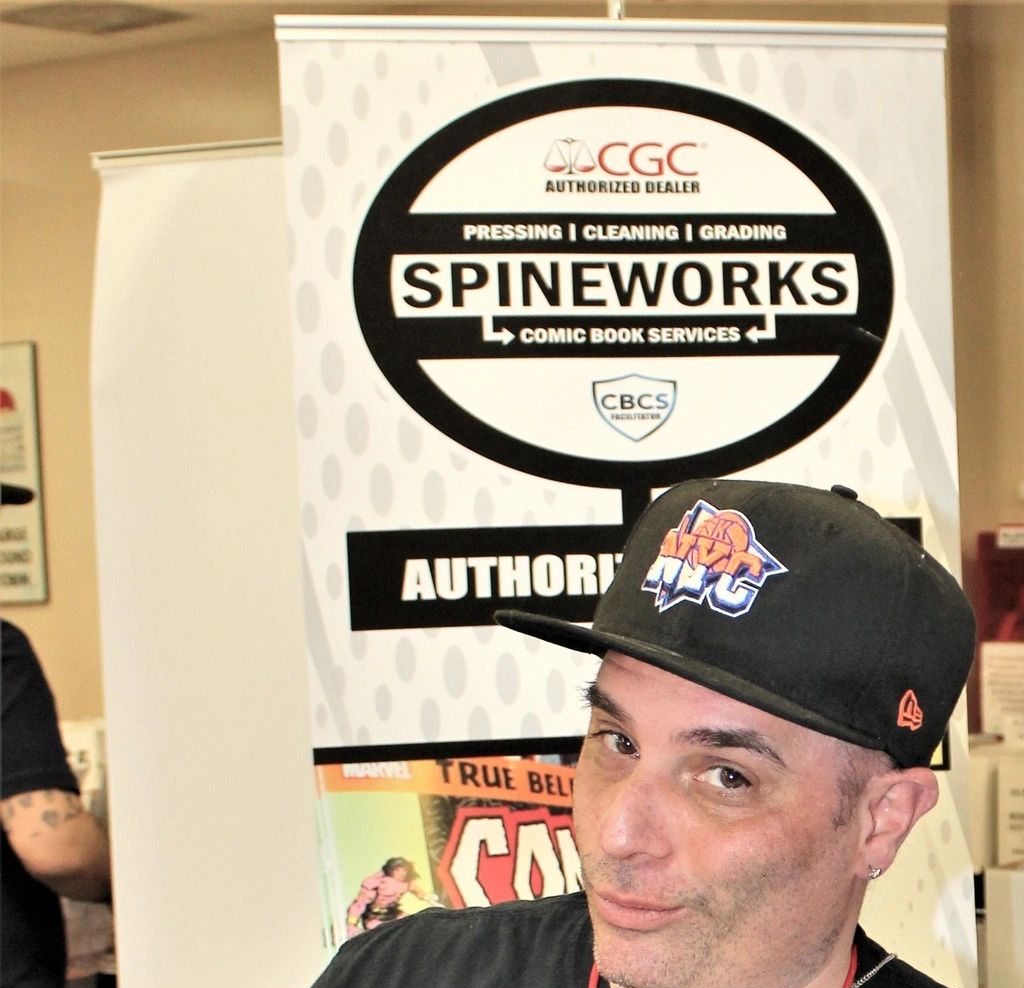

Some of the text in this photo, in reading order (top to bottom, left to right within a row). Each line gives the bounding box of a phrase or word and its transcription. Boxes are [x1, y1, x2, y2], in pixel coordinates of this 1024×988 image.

[597, 142, 699, 176] CGC
[545, 180, 701, 194] AUTHORIZED DEALER
[463, 224, 787, 242] PRESSING CLEANING GRADING
[402, 260, 850, 309] SPINEWORKS
[520, 327, 741, 344] COMIC BOOK SERVICES
[601, 394, 669, 410] CBCS
[402, 553, 623, 601] AUTHORI
[436, 759, 516, 790] TRUE
